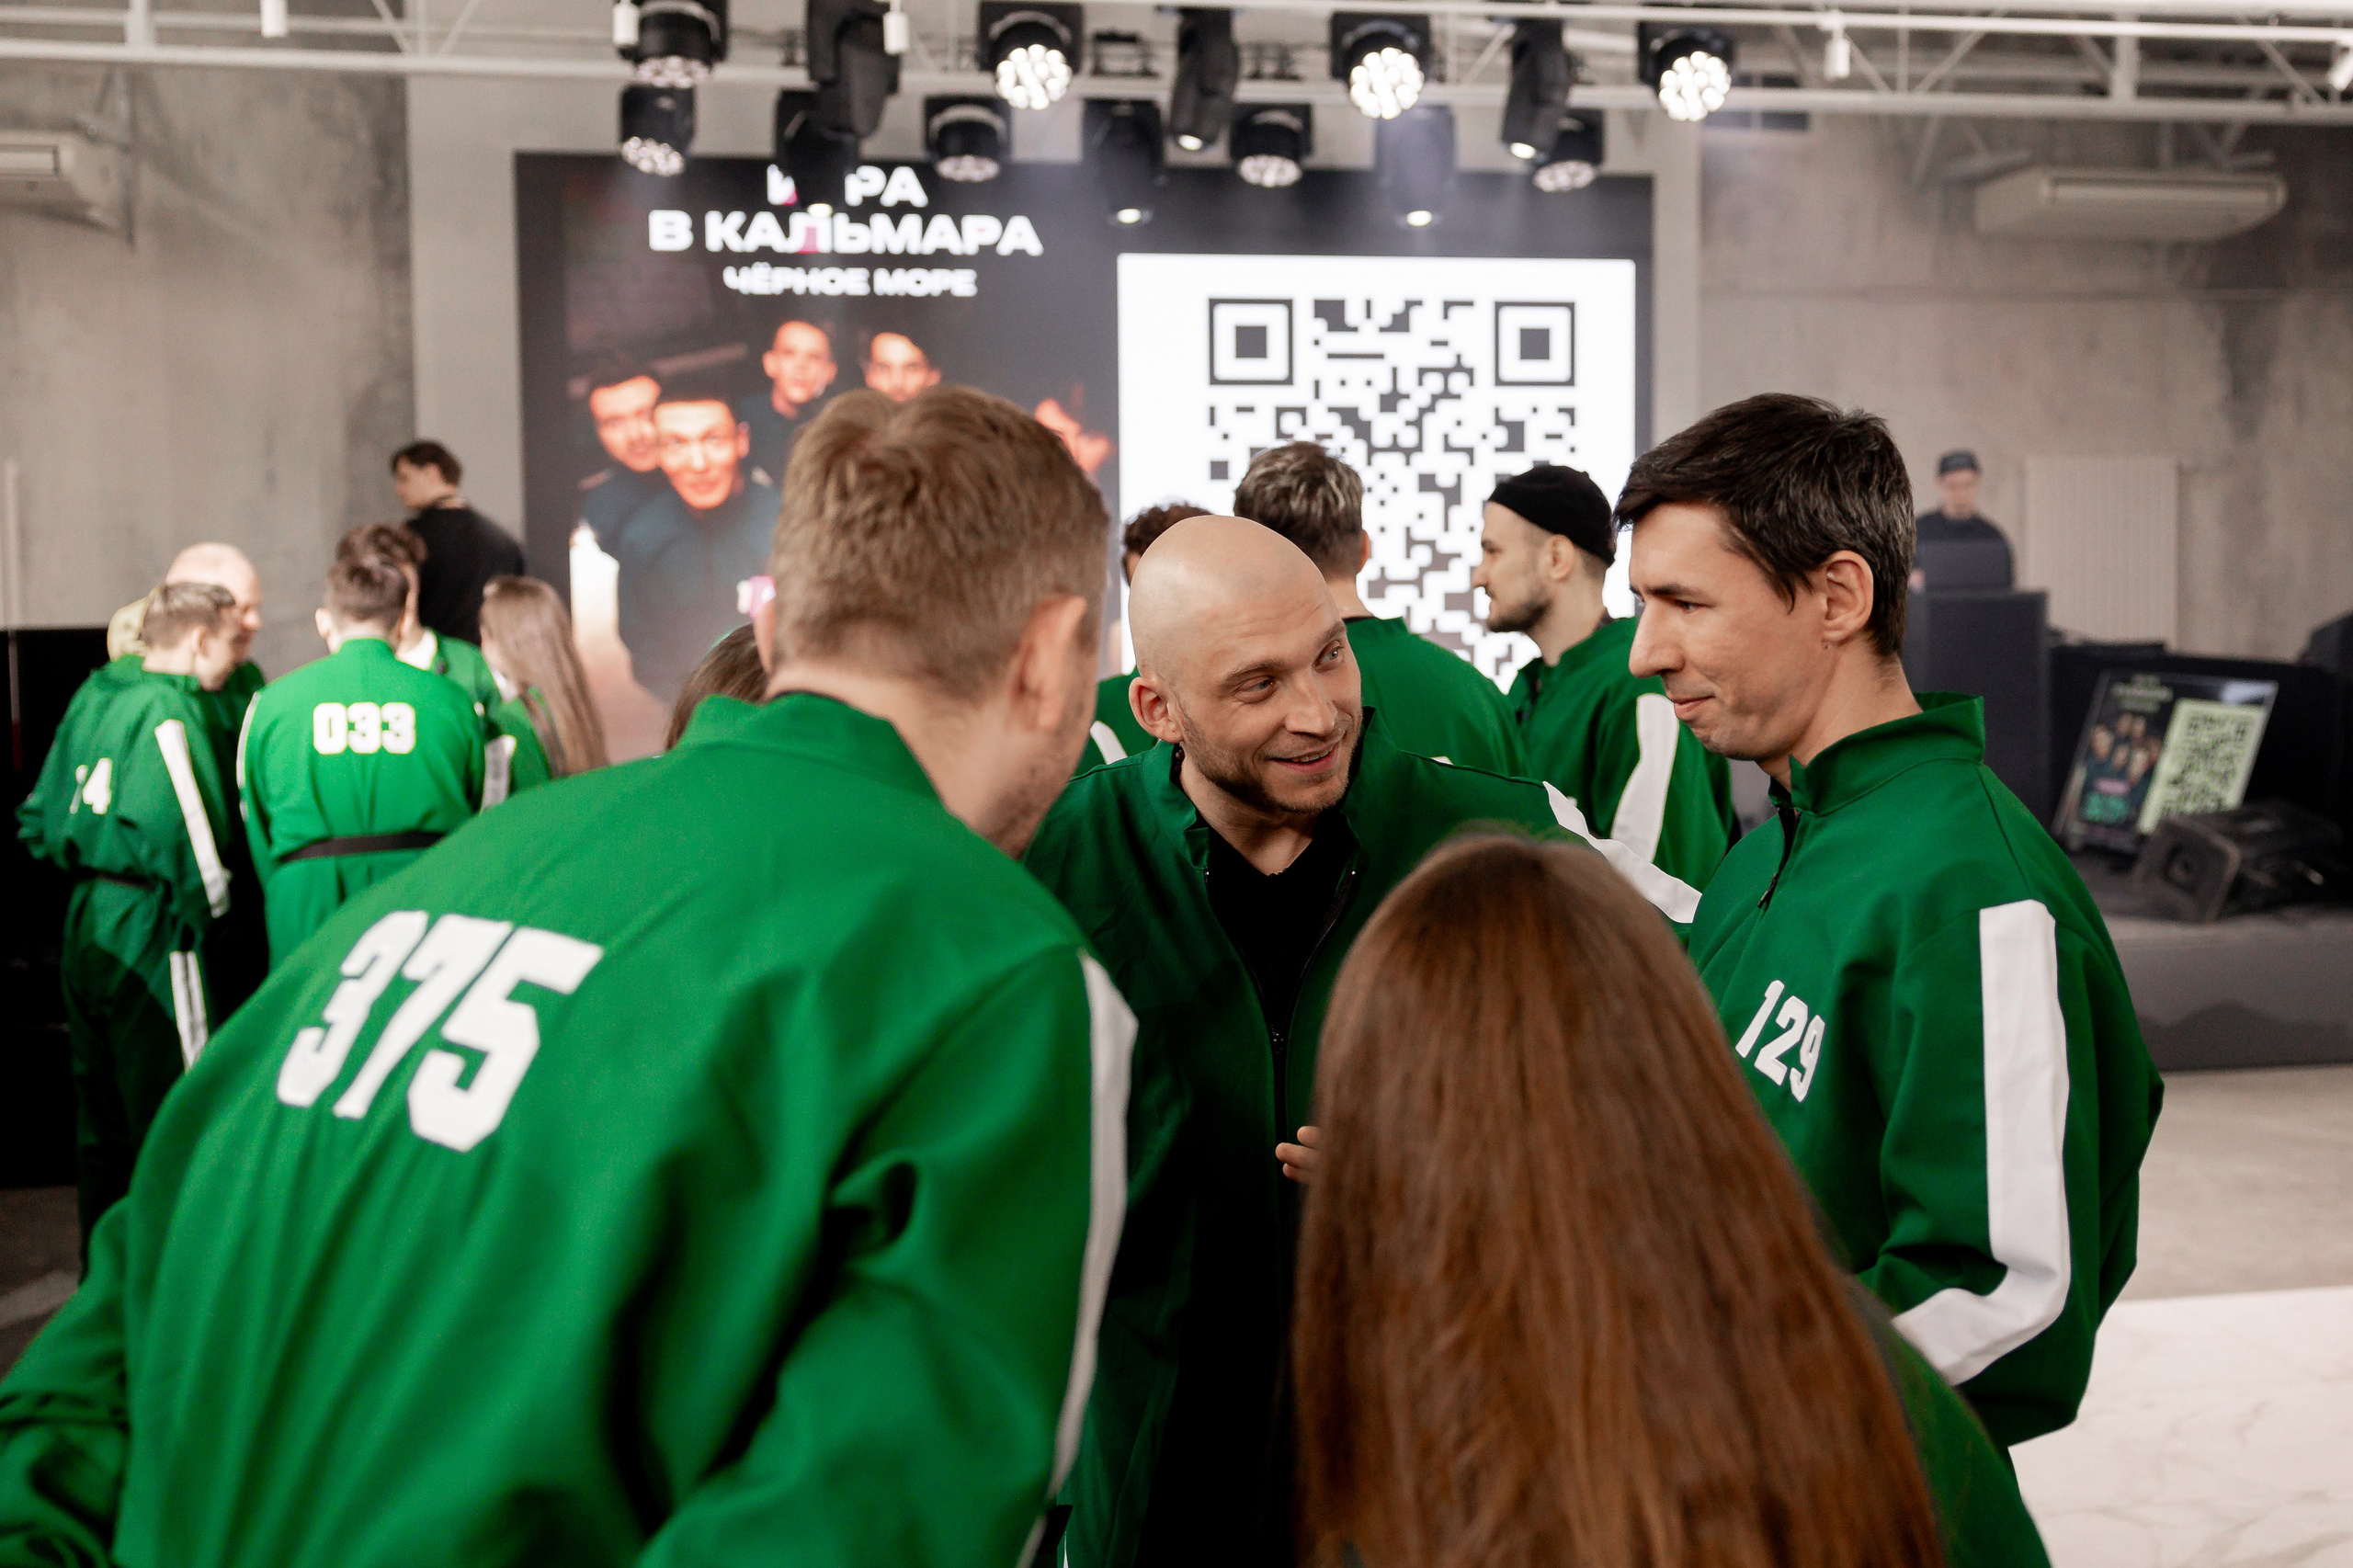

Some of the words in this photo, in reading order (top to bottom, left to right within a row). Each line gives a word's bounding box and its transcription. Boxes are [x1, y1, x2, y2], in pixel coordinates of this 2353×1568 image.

[767, 164, 929, 208] ИРА
[648, 210, 694, 252] В
[704, 210, 1044, 256] КАЛЬМАРА
[722, 261, 870, 296] ЧЁРНОЕ
[872, 267, 978, 297] МОРЕ
[313, 702, 415, 755] 033
[277, 910, 604, 1153] 375
[1734, 979, 1826, 1103] 129
